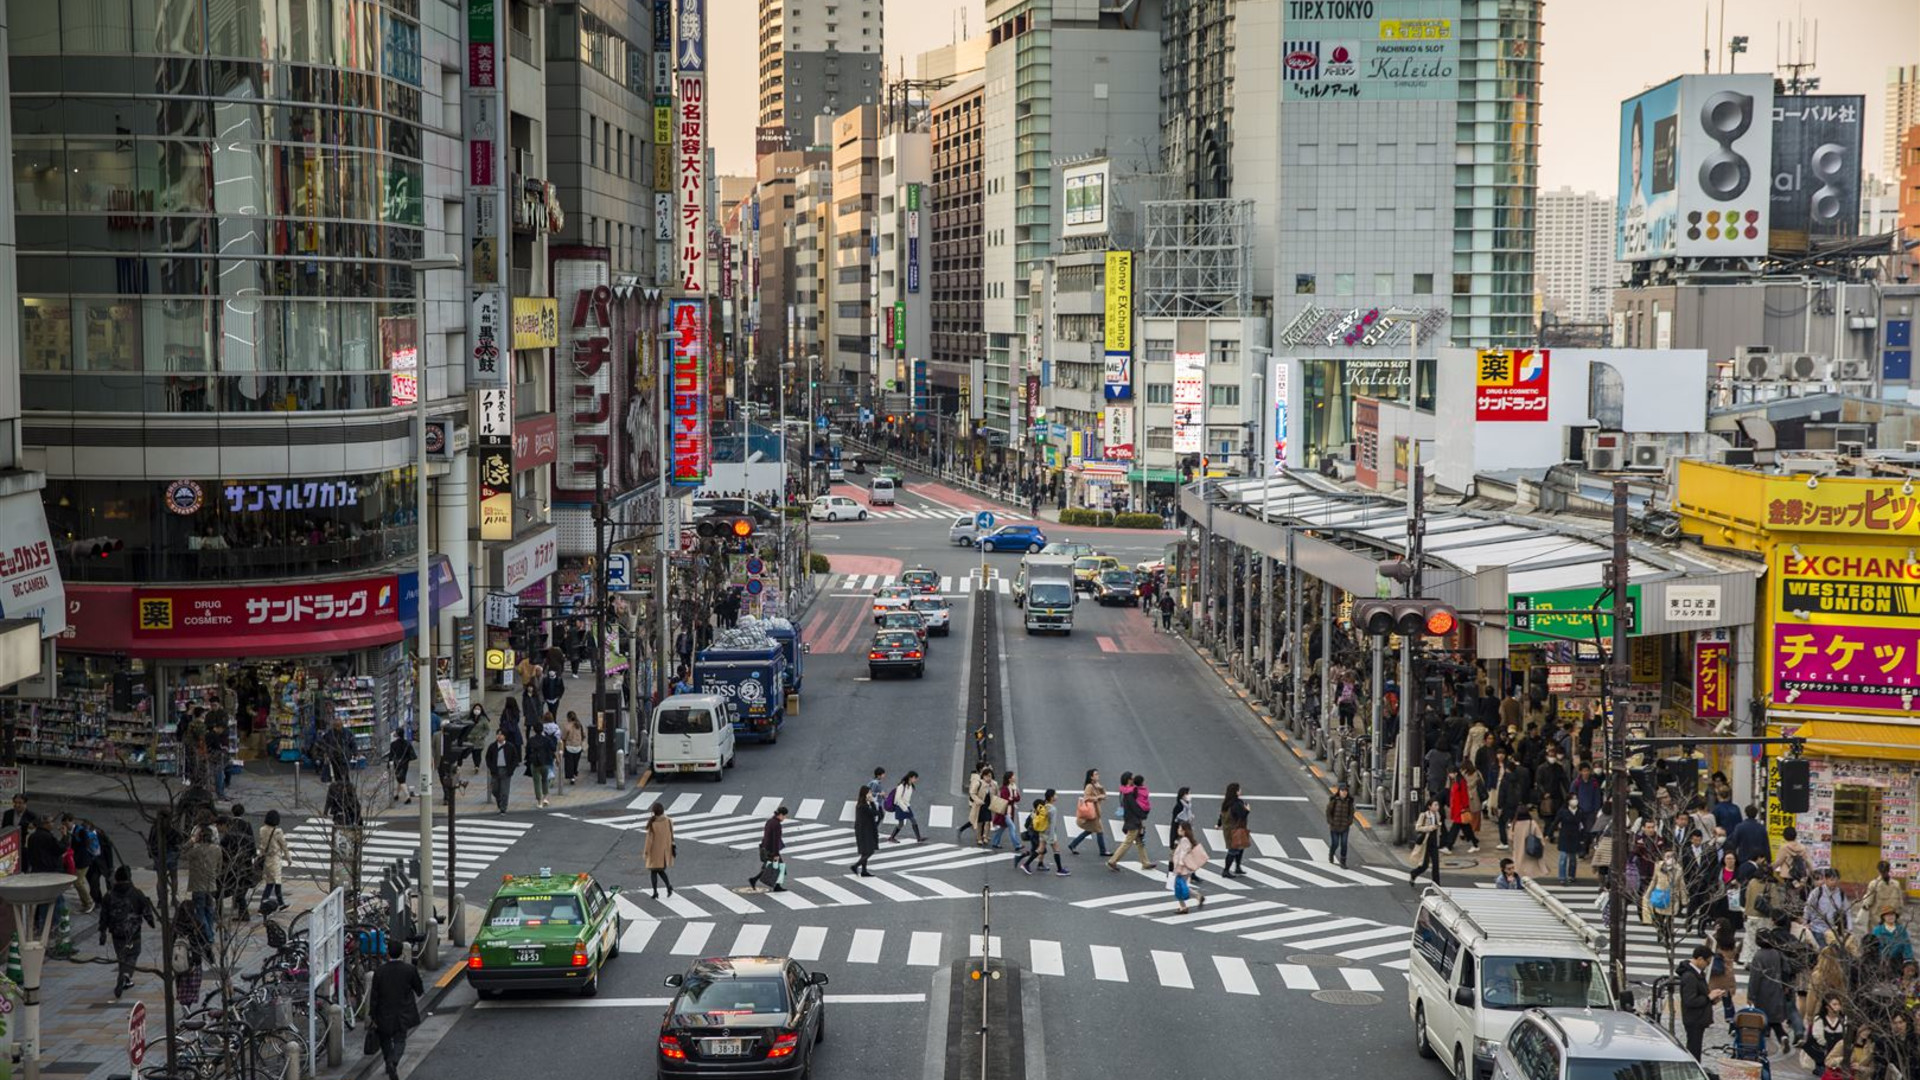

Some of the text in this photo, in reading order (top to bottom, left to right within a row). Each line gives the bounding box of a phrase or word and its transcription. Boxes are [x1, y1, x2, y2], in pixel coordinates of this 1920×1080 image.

[1291, 1, 1374, 19] TIP.X TOKYO
[478, 45, 492, 85] 美容室
[680, 78, 702, 291] 100名収容大パーティールーム
[1771, 163, 1801, 191] al
[1118, 256, 1128, 292] Money
[573, 285, 612, 475] パチンコ
[1481, 355, 1509, 381] 薬
[675, 304, 698, 478] パチンコジャンボ
[1477, 397, 1547, 411] サンドラッグ
[224, 480, 357, 512] サンマルクカフェ
[1767, 488, 1920, 531] 金券ショップビッ
[534, 541, 554, 570] カラオケ
[12, 575, 50, 598] BIC CAMERA
[1788, 582, 1892, 598] WESTERN
[142, 600, 170, 627] 薬
[194, 600, 221, 609] DRUG
[245, 589, 368, 624] サンドラッグ
[1820, 597, 1891, 613] UNION
[184, 615, 232, 626] COSMETIC
[1780, 633, 1920, 673] チケッ
[701, 685, 736, 696] BOSS
[1699, 648, 1718, 712] チケット
[1780, 671, 1866, 682] TICKET
